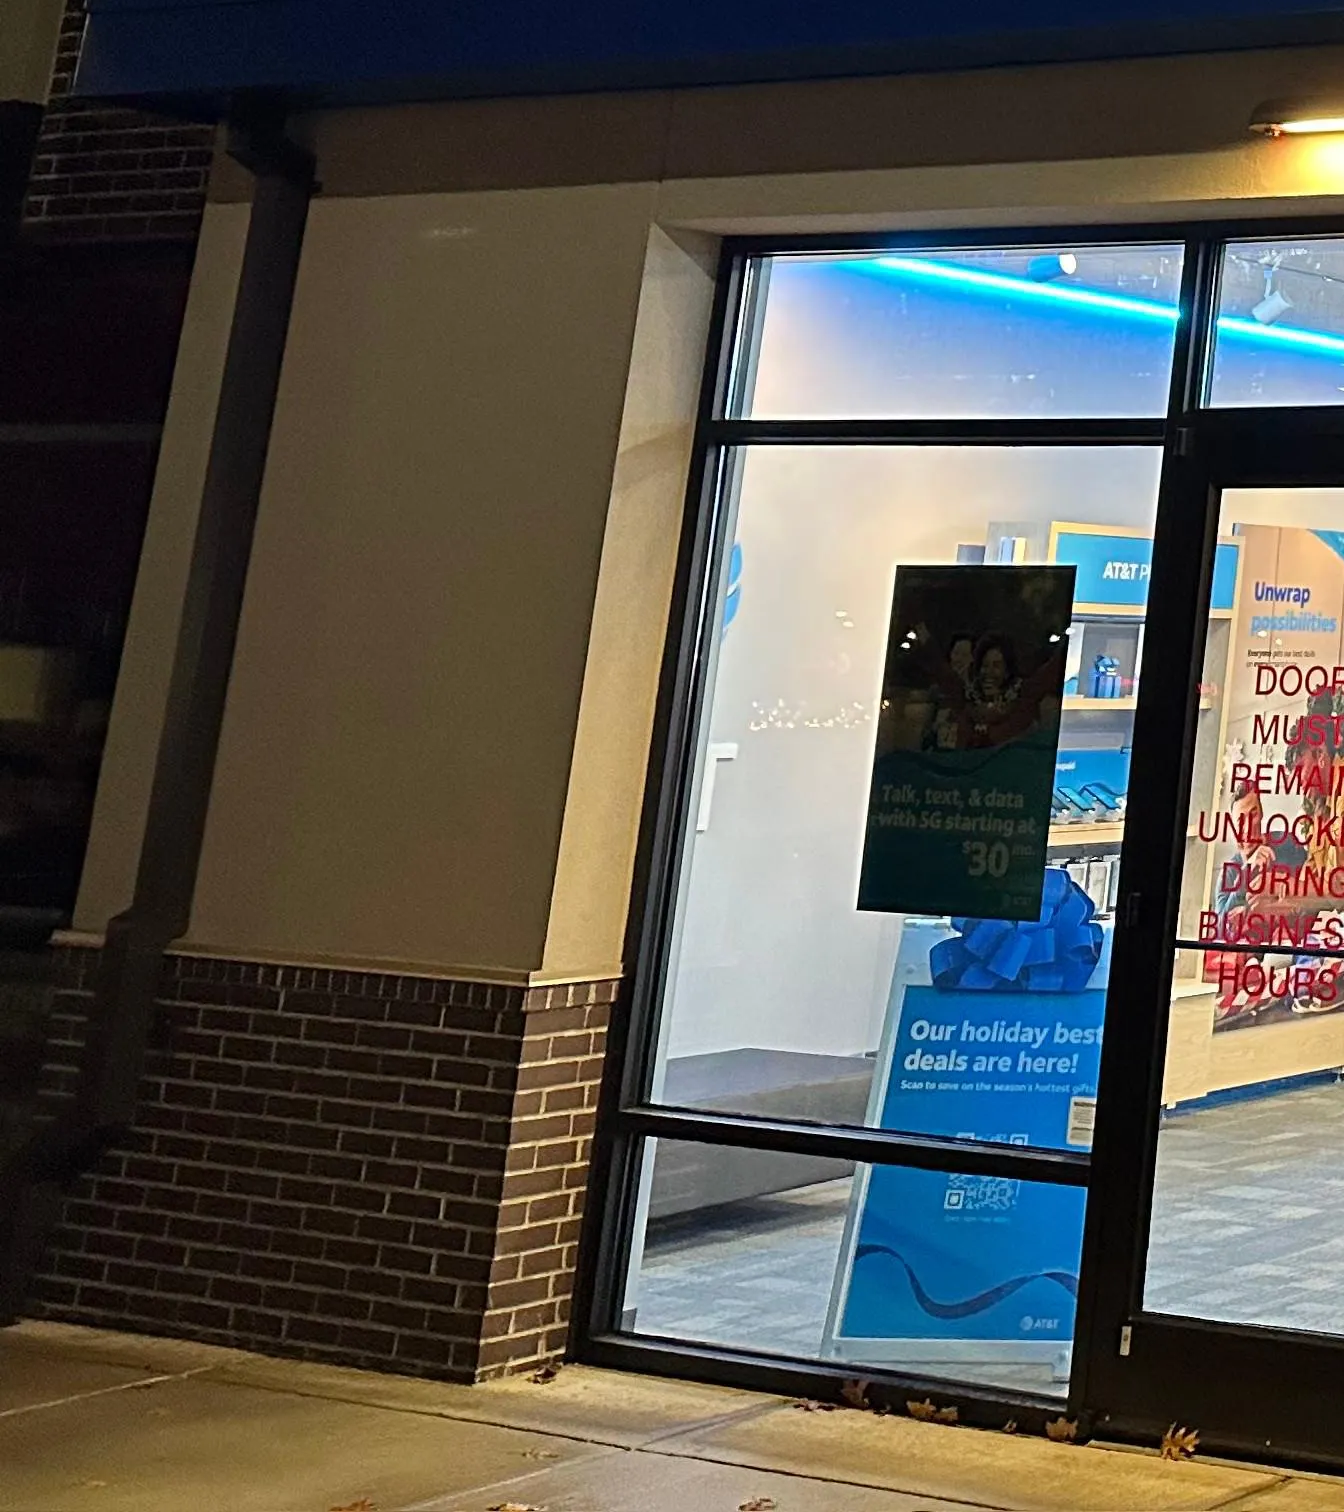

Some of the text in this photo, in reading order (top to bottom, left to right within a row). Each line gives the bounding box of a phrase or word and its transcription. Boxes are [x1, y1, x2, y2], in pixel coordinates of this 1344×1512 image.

[1103, 561, 1138, 580] AT&T
[1254, 581, 1311, 608] Unwrap
[1250, 610, 1338, 636] possibilities
[882, 783, 1024, 809] Talk, text, & data
[878, 808, 1037, 838] with 5G starting at
[962, 839, 1010, 878] $30
[1218, 963, 1338, 1002] HOURS
[910, 1018, 1104, 1049] Our holiday best
[904, 1047, 1080, 1074] deals are here!
[900, 1079, 924, 1090] Scan
[925, 1081, 937, 1090] to
[938, 1082, 960, 1091] save
[961, 1082, 974, 1091] on
[975, 1081, 991, 1092] the
[993, 1082, 1034, 1092] season's
[1035, 1082, 1071, 1093] hottest
[1033, 1318, 1060, 1329] AT&T
